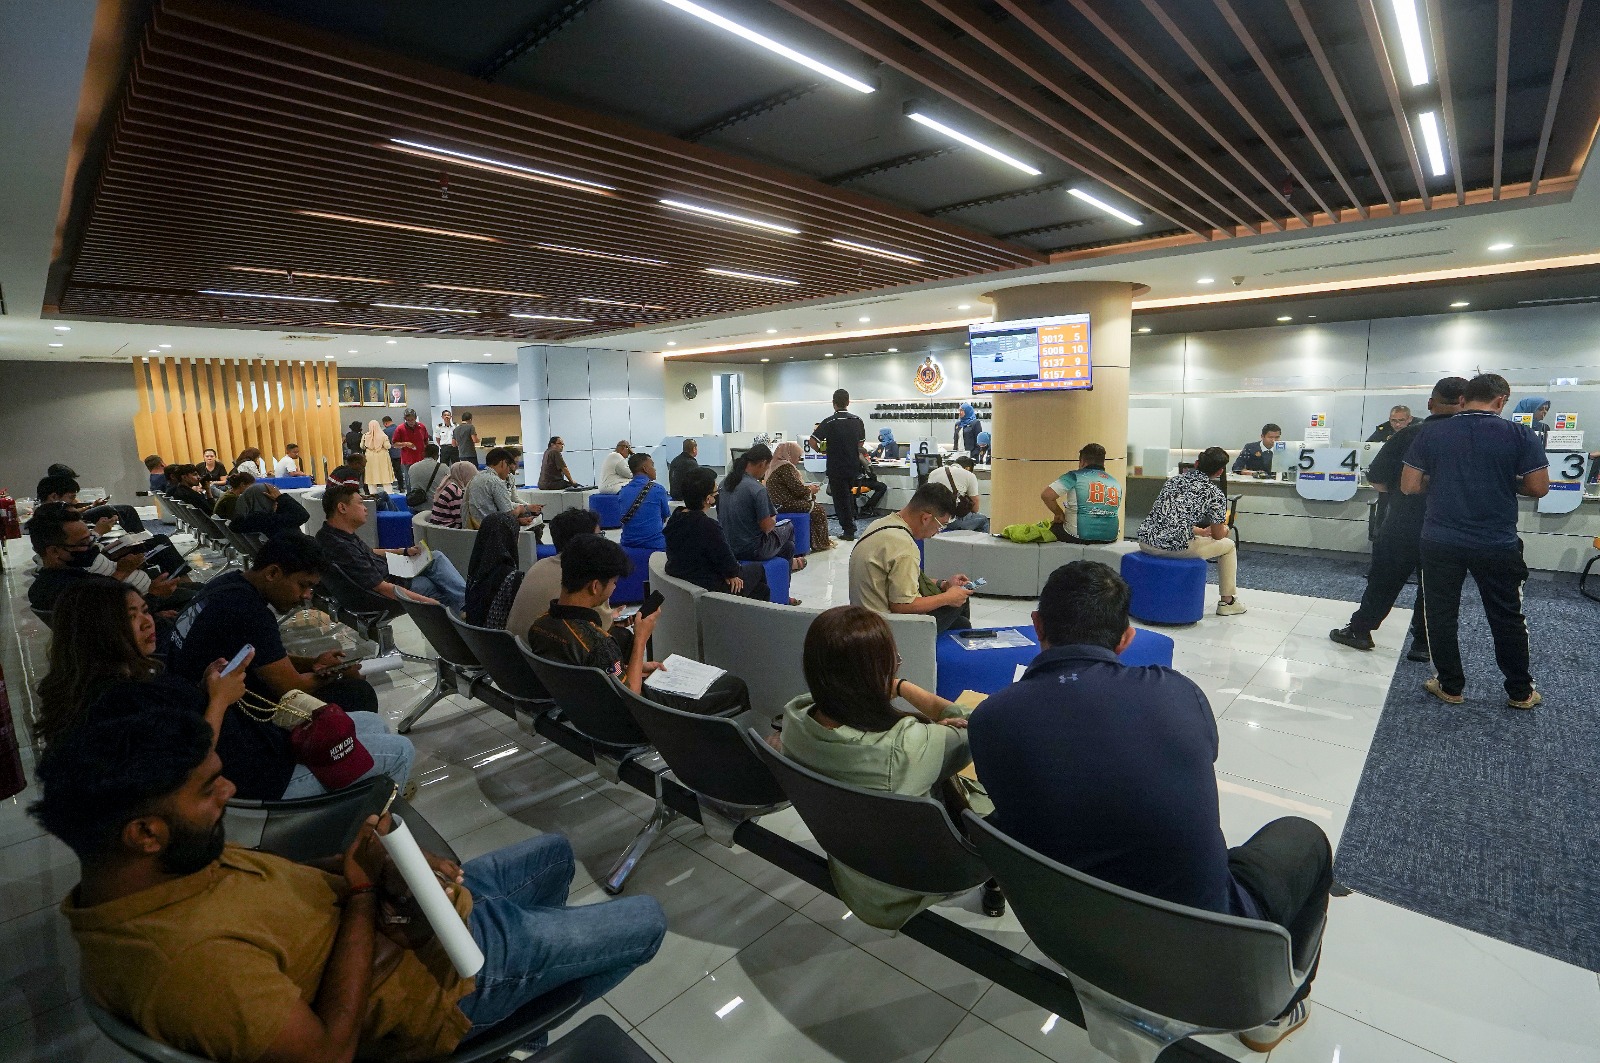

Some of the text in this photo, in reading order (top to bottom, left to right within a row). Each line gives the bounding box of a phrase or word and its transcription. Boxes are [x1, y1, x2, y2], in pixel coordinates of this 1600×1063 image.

[1041, 332, 1080, 344] 3012 5
[1042, 345, 1083, 356] 5008 10
[1042, 357, 1081, 368] 6137 9
[1043, 369, 1081, 380] 6157 6
[803, 439, 811, 453] 8
[919, 441, 929, 454] 6
[1298, 448, 1315, 470] 5
[1340, 449, 1359, 472] 4
[1561, 453, 1585, 480] 3
[1086, 481, 1119, 508] 89
